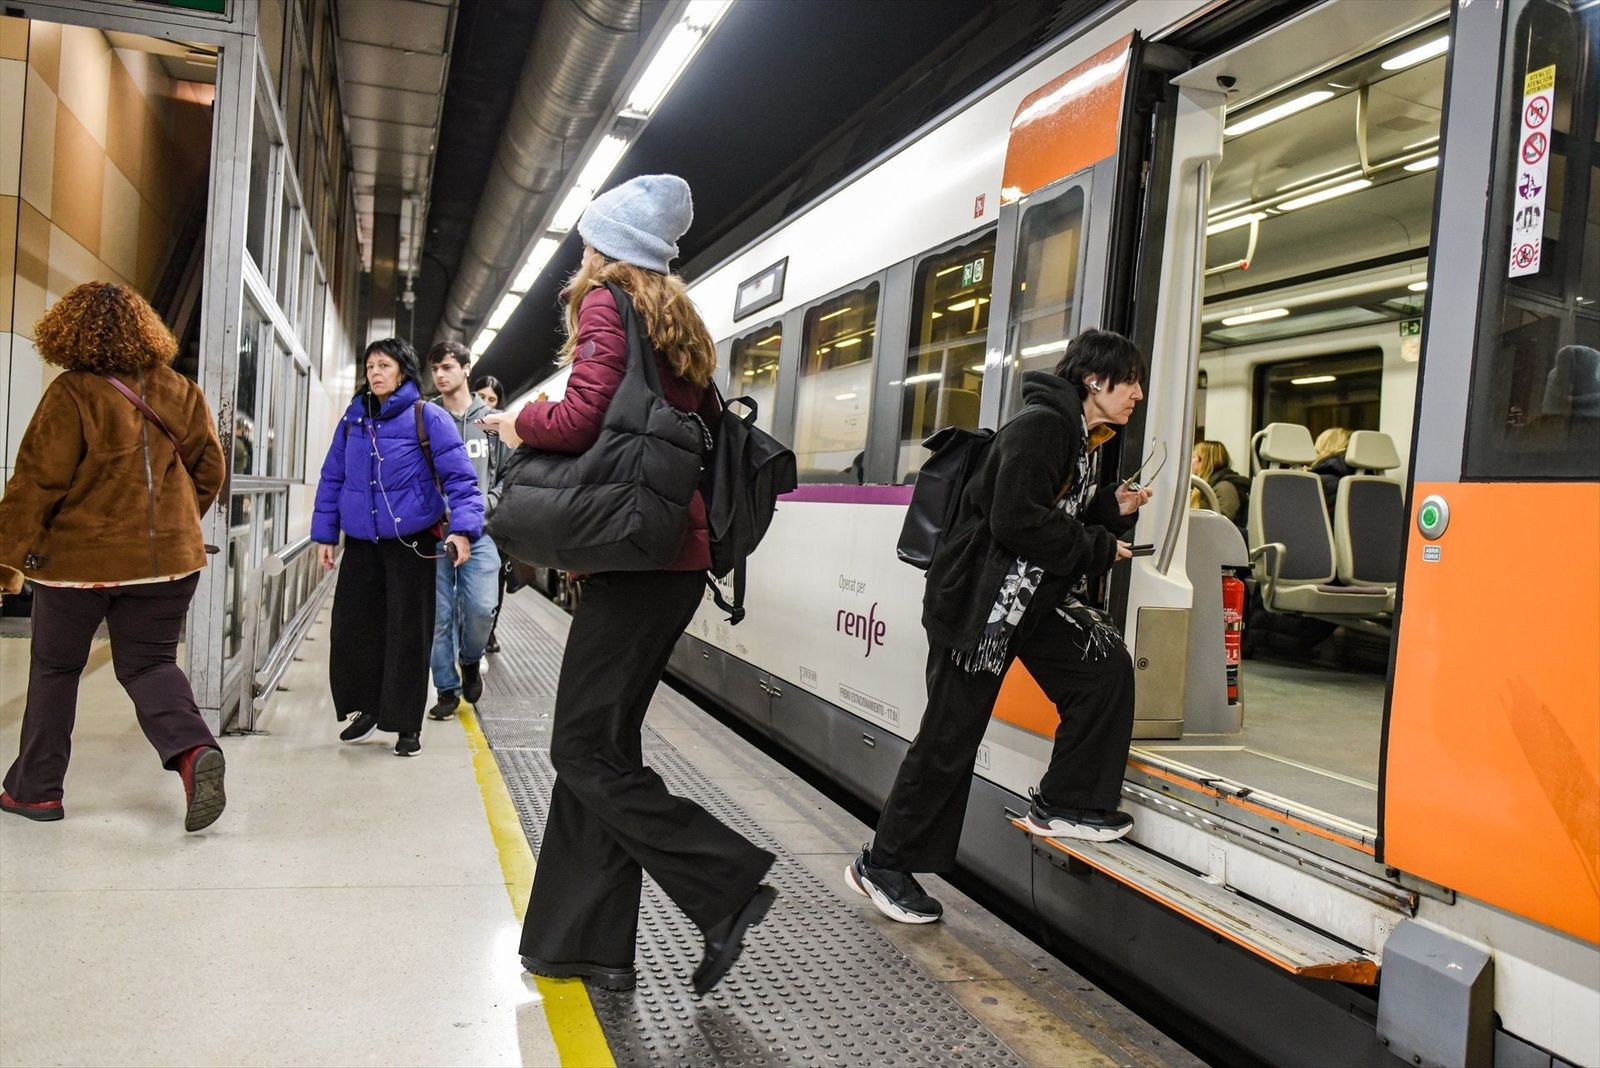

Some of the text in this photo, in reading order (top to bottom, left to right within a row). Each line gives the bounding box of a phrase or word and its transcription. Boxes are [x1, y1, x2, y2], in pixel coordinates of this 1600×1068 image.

[838, 573, 866, 596] Operat per
[836, 602, 886, 658] renfe
